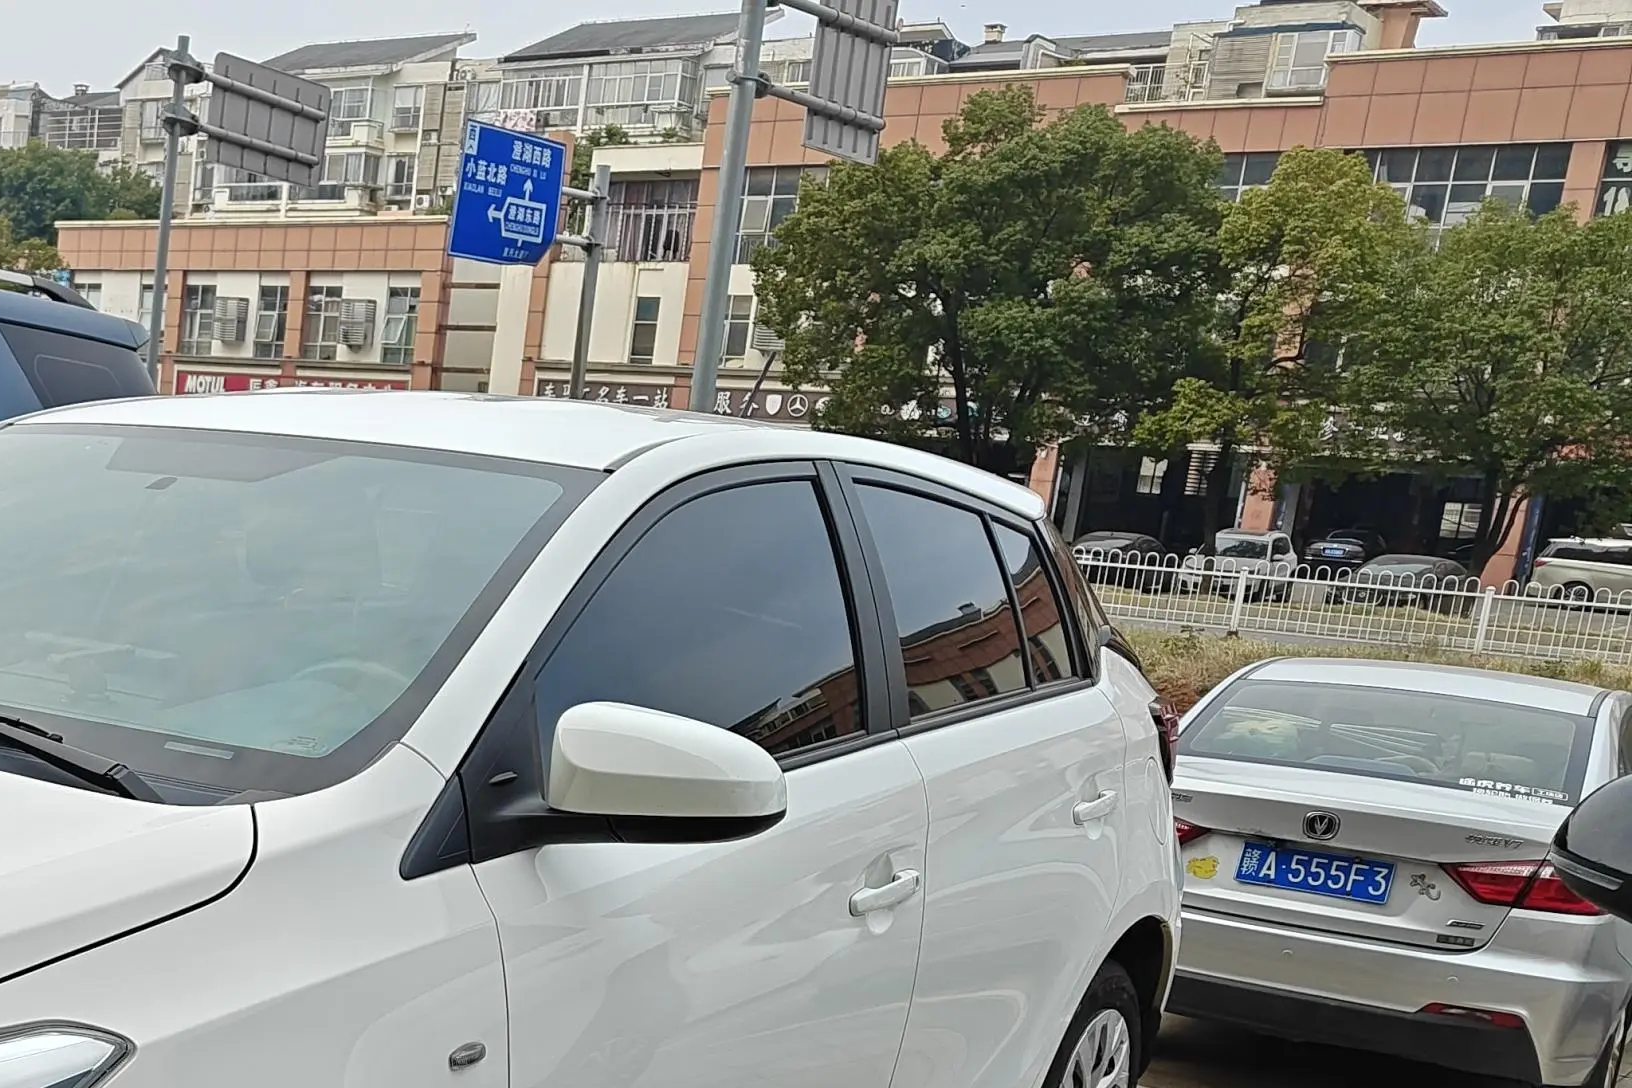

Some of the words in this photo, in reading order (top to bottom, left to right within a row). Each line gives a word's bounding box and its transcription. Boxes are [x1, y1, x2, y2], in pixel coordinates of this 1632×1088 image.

[465, 157, 508, 186] 小蓝北路
[507, 204, 542, 226] 澄湖东路
[184, 374, 227, 394] MOTUL
